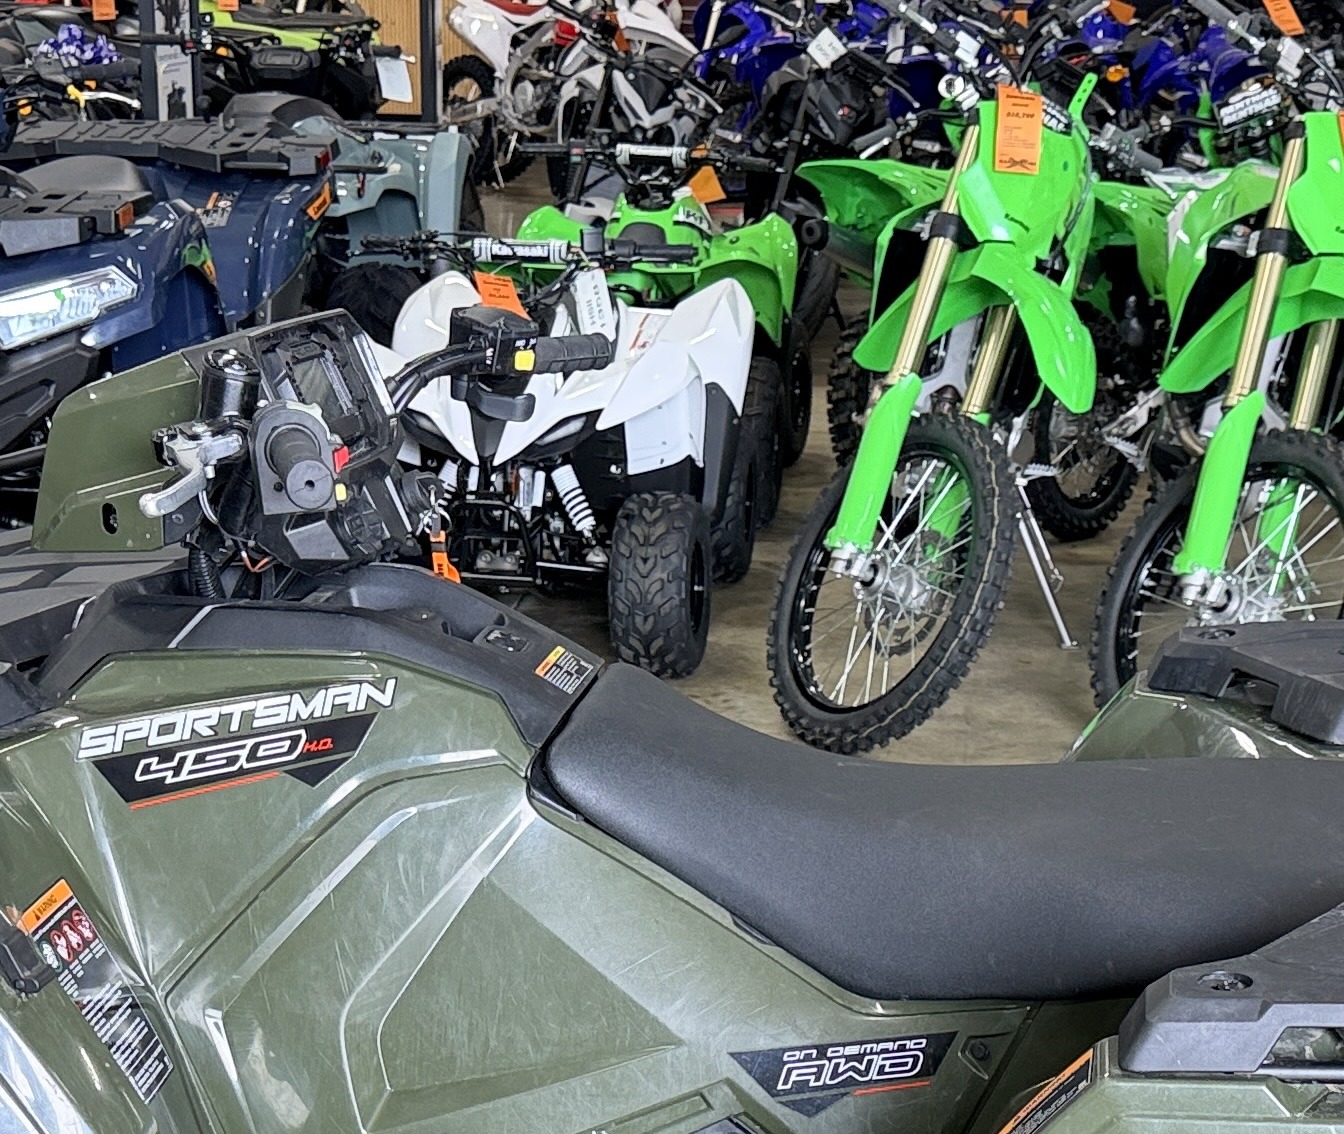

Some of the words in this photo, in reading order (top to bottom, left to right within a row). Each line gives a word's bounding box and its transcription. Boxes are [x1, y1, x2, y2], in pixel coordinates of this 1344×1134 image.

[76, 677, 398, 760] SPORTSMAN
[134, 729, 308, 784] 450
[776, 1050, 924, 1091] AWD
[782, 1049, 819, 1062] ON
[826, 1038, 928, 1058] DEMAND
